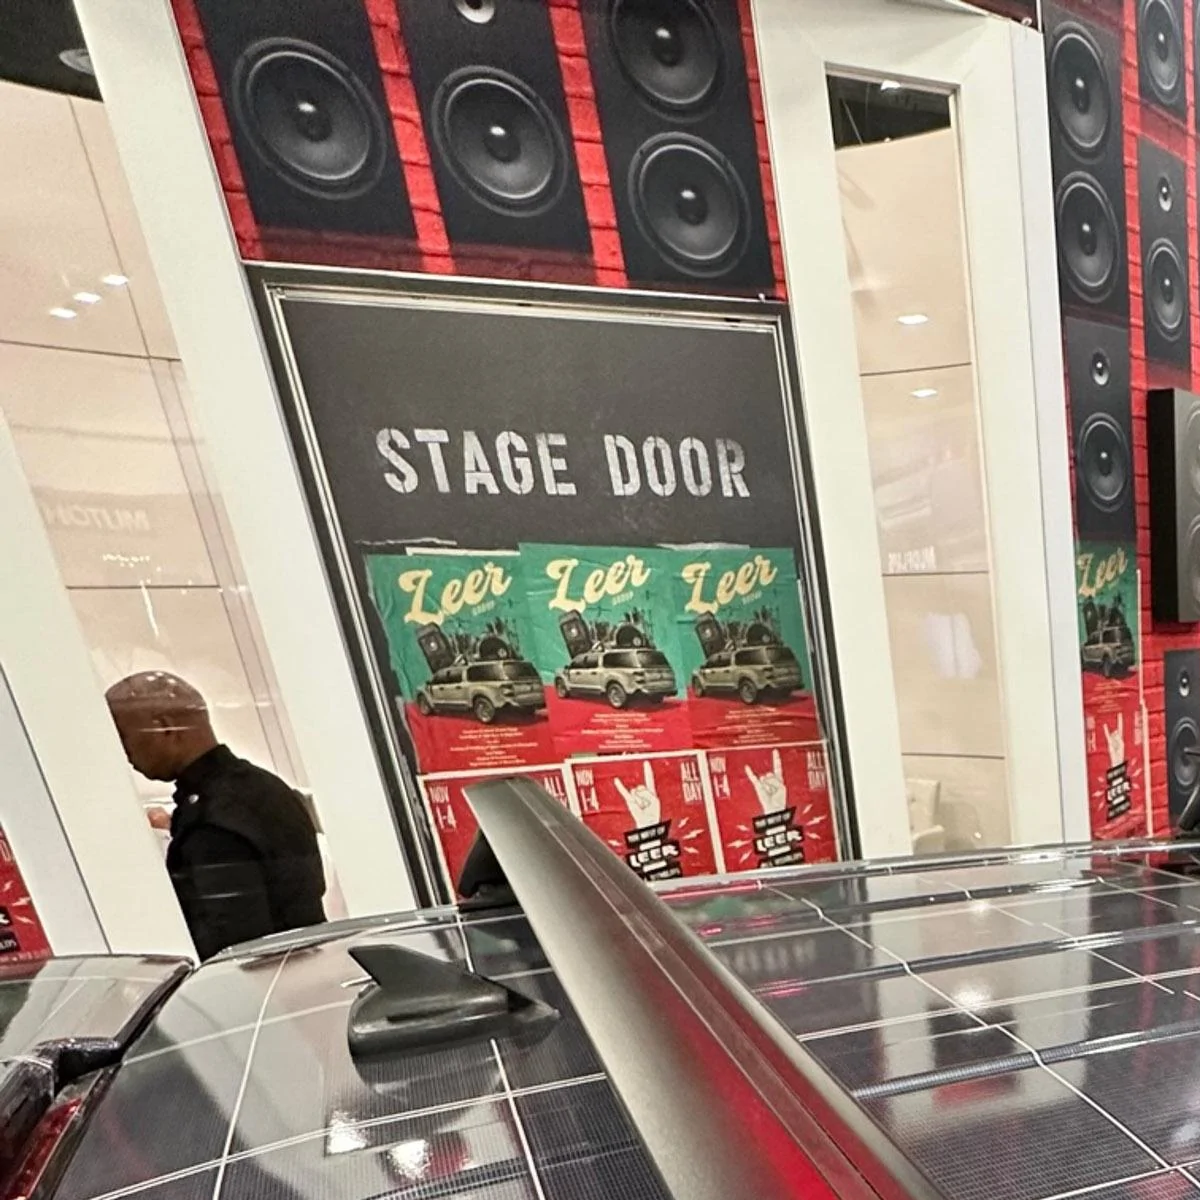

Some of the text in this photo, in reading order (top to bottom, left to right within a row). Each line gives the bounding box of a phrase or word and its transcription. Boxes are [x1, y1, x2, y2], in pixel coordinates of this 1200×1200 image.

[376, 428, 750, 498] STAGE DOOR
[398, 562, 512, 626] Leer
[546, 554, 651, 613] Leer
[681, 554, 778, 614] Leer
[629, 844, 679, 868] LEER
